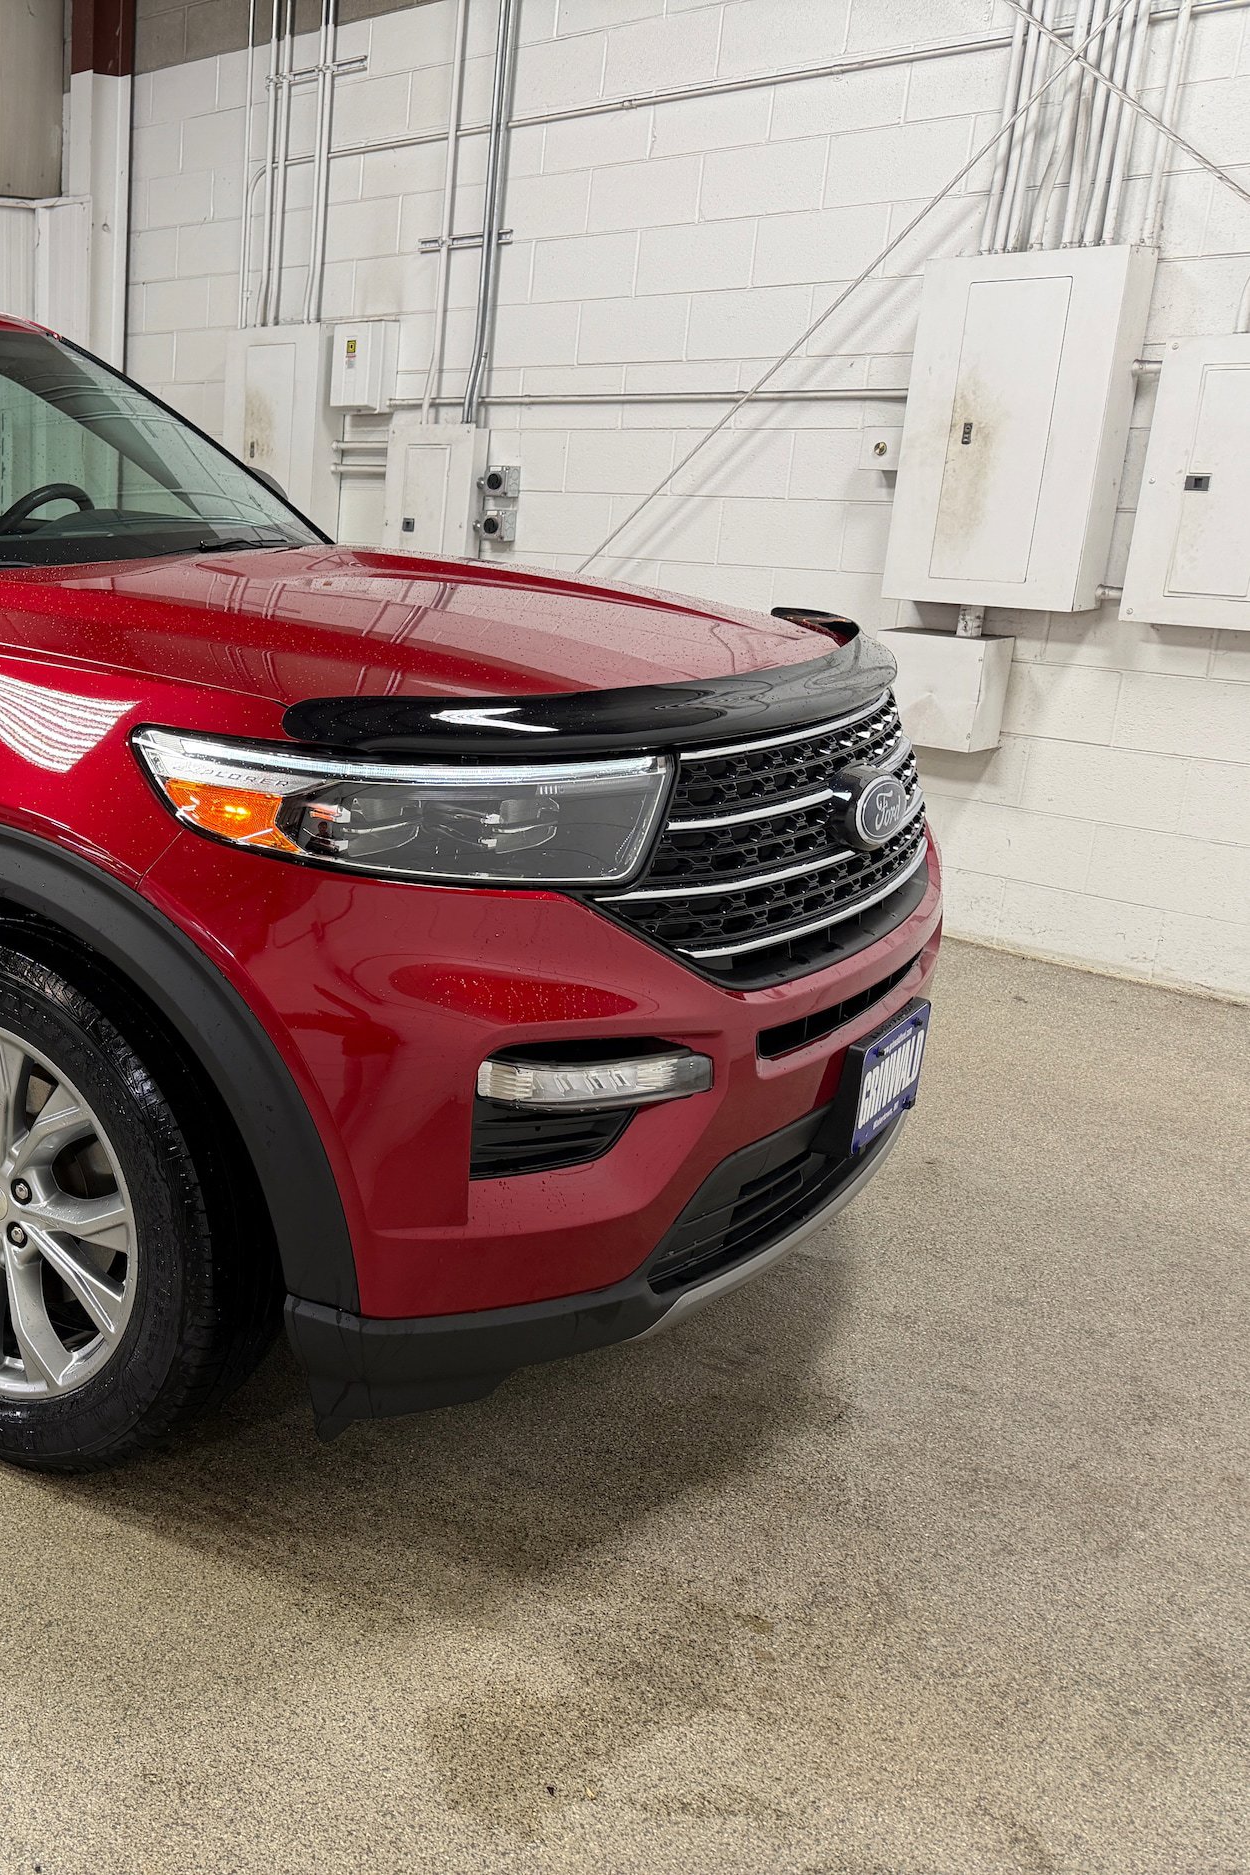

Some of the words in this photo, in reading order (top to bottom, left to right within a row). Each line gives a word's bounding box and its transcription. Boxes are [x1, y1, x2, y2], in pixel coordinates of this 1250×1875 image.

[172, 760, 290, 788] EXPLORER
[874, 789, 902, 831] Ford
[857, 1029, 925, 1130] GRINWALD
